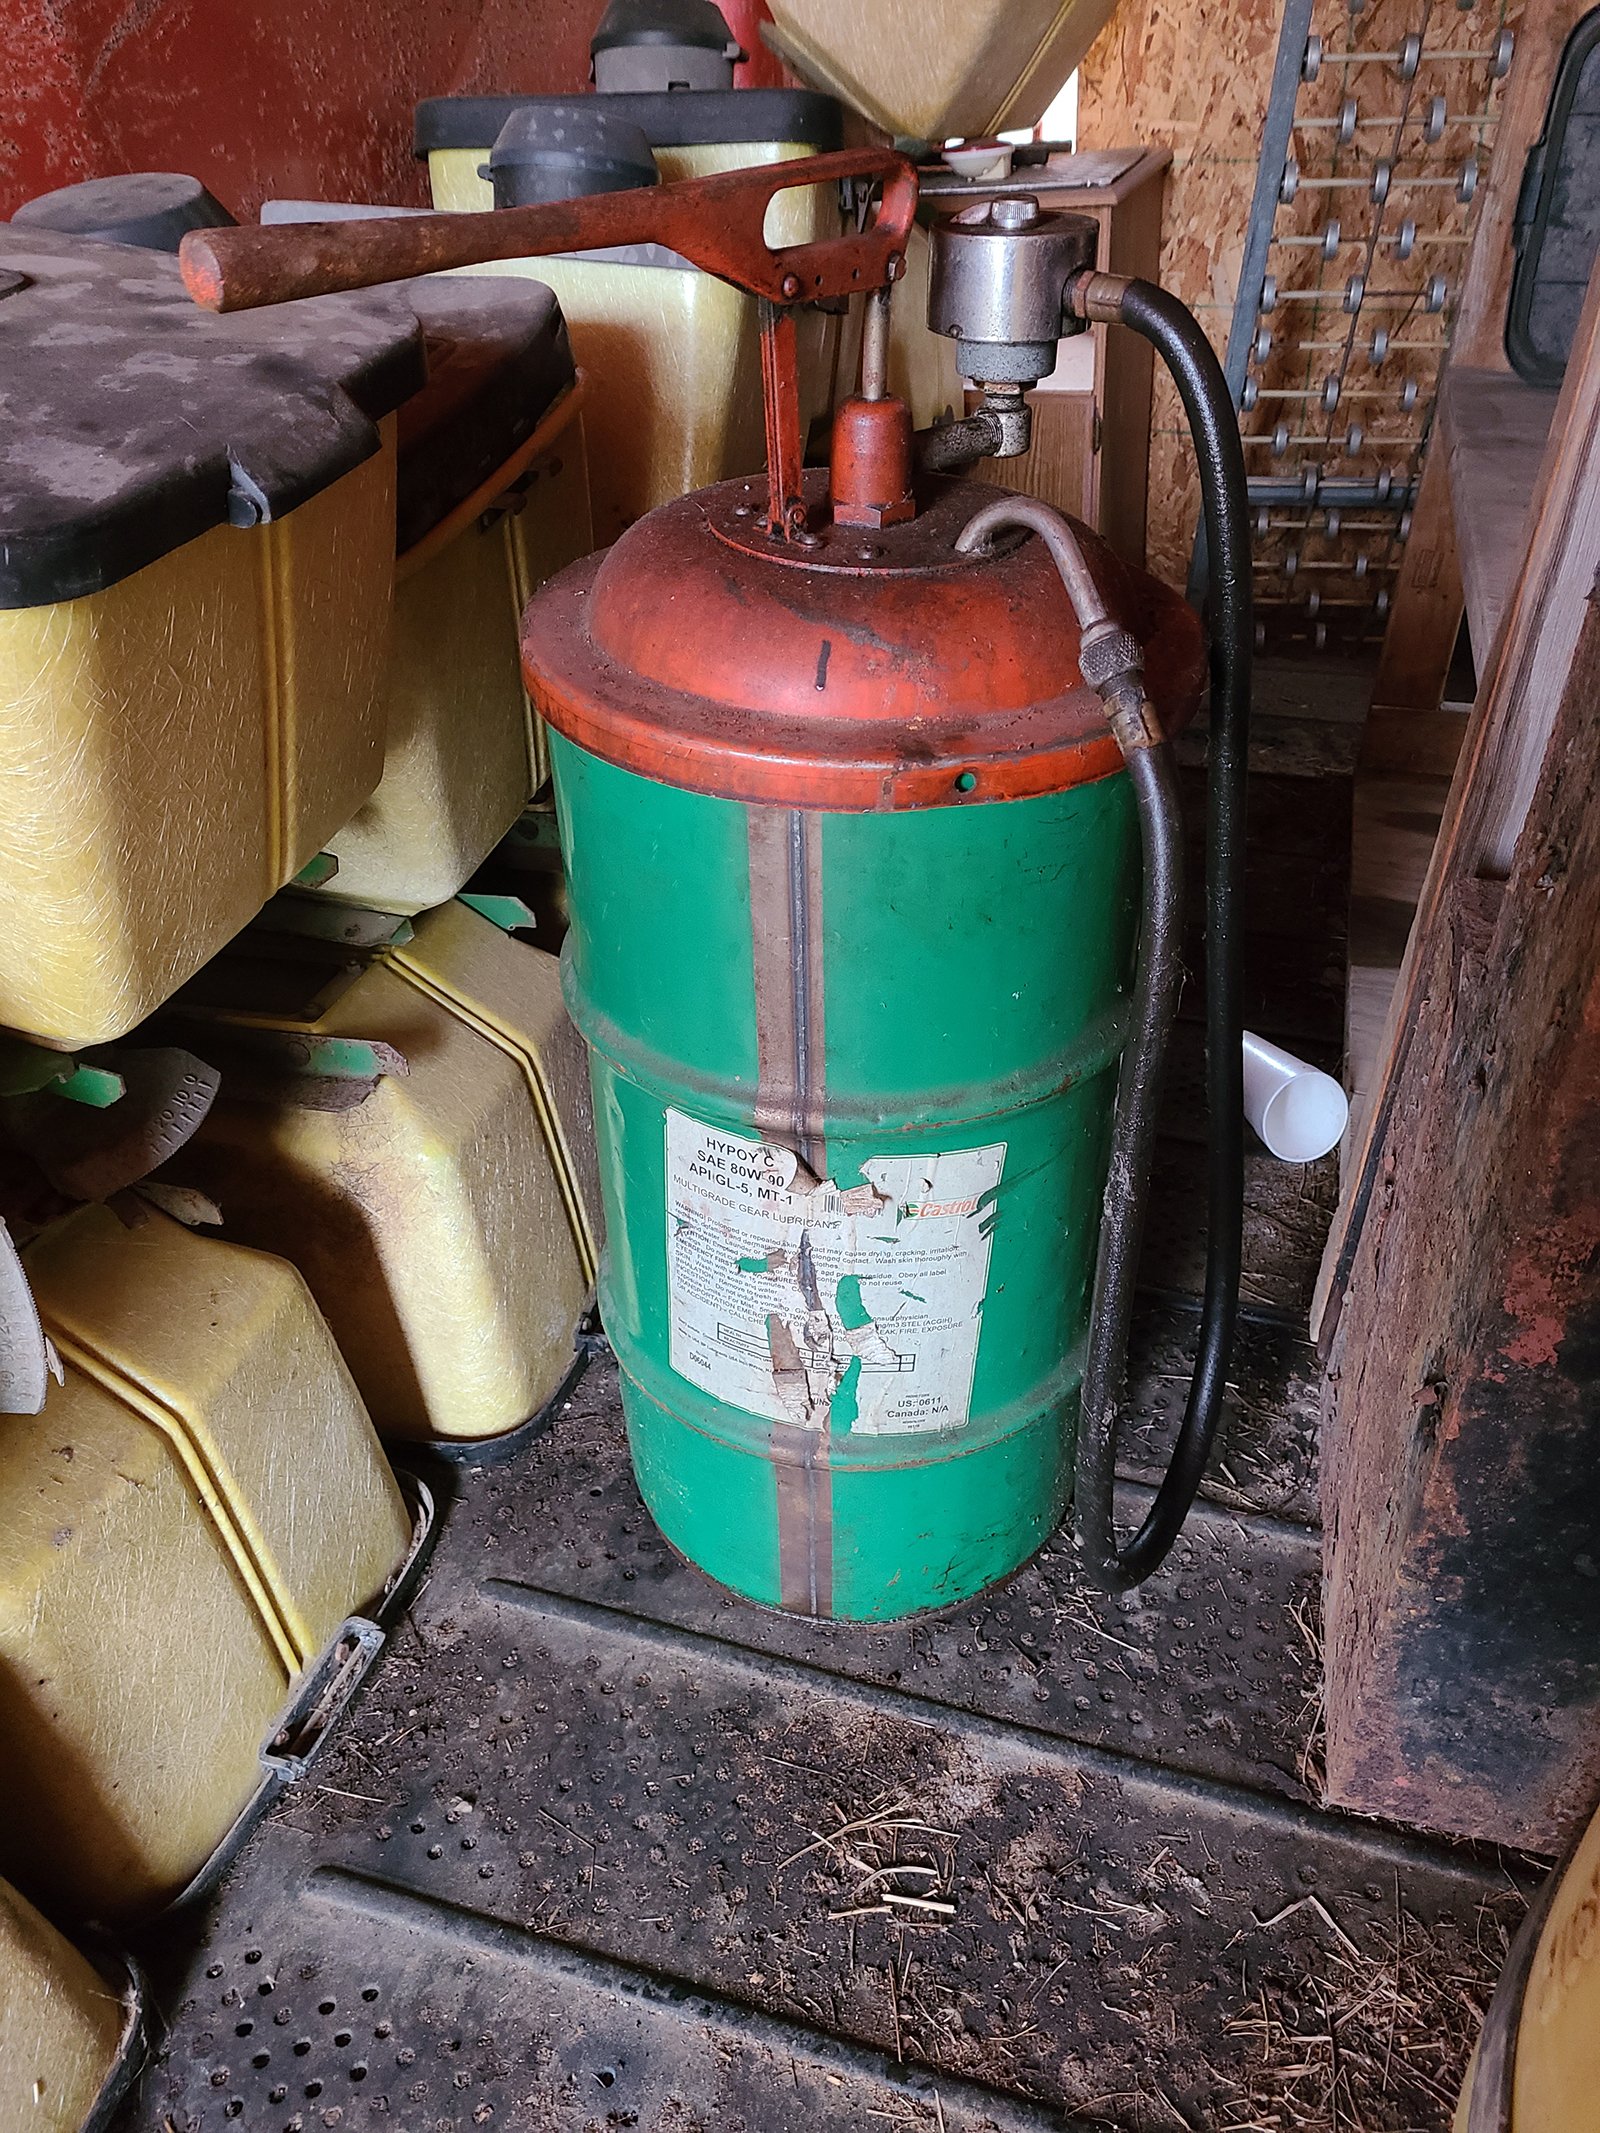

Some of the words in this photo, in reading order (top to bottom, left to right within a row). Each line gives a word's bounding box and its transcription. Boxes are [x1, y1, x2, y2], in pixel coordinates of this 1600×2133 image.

[706, 1137, 758, 1163] HYPOY
[763, 1155, 774, 1167] C
[697, 1149, 726, 1170] SAE
[689, 1162, 711, 1181] API
[715, 1173, 753, 1197] GL-5,
[757, 1187, 792, 1205] MT-1
[673, 1174, 736, 1210] MULTIGRADE
[738, 1203, 770, 1219] GEAR
[919, 1197, 978, 1217] Castrol
[707, 1216, 740, 1235] Prolonged
[749, 1233, 781, 1246] repeated
[827, 1247, 843, 1256] may
[844, 1250, 867, 1258] cause
[725, 1238, 752, 1253] Launder
[914, 1253, 952, 1262] thoroughly
[898, 1271, 918, 1279] Obey
[929, 1268, 947, 1277] label
[728, 1308, 747, 1322] CALL
[900, 1320, 922, 1328] STEL
[922, 1317, 953, 1327] (ACGIH)
[921, 1321, 964, 1333] EXPOSURE
[918, 1396, 941, 1407] 0611
[887, 1408, 929, 1418] Canada:
[931, 1404, 949, 1414] N/A
